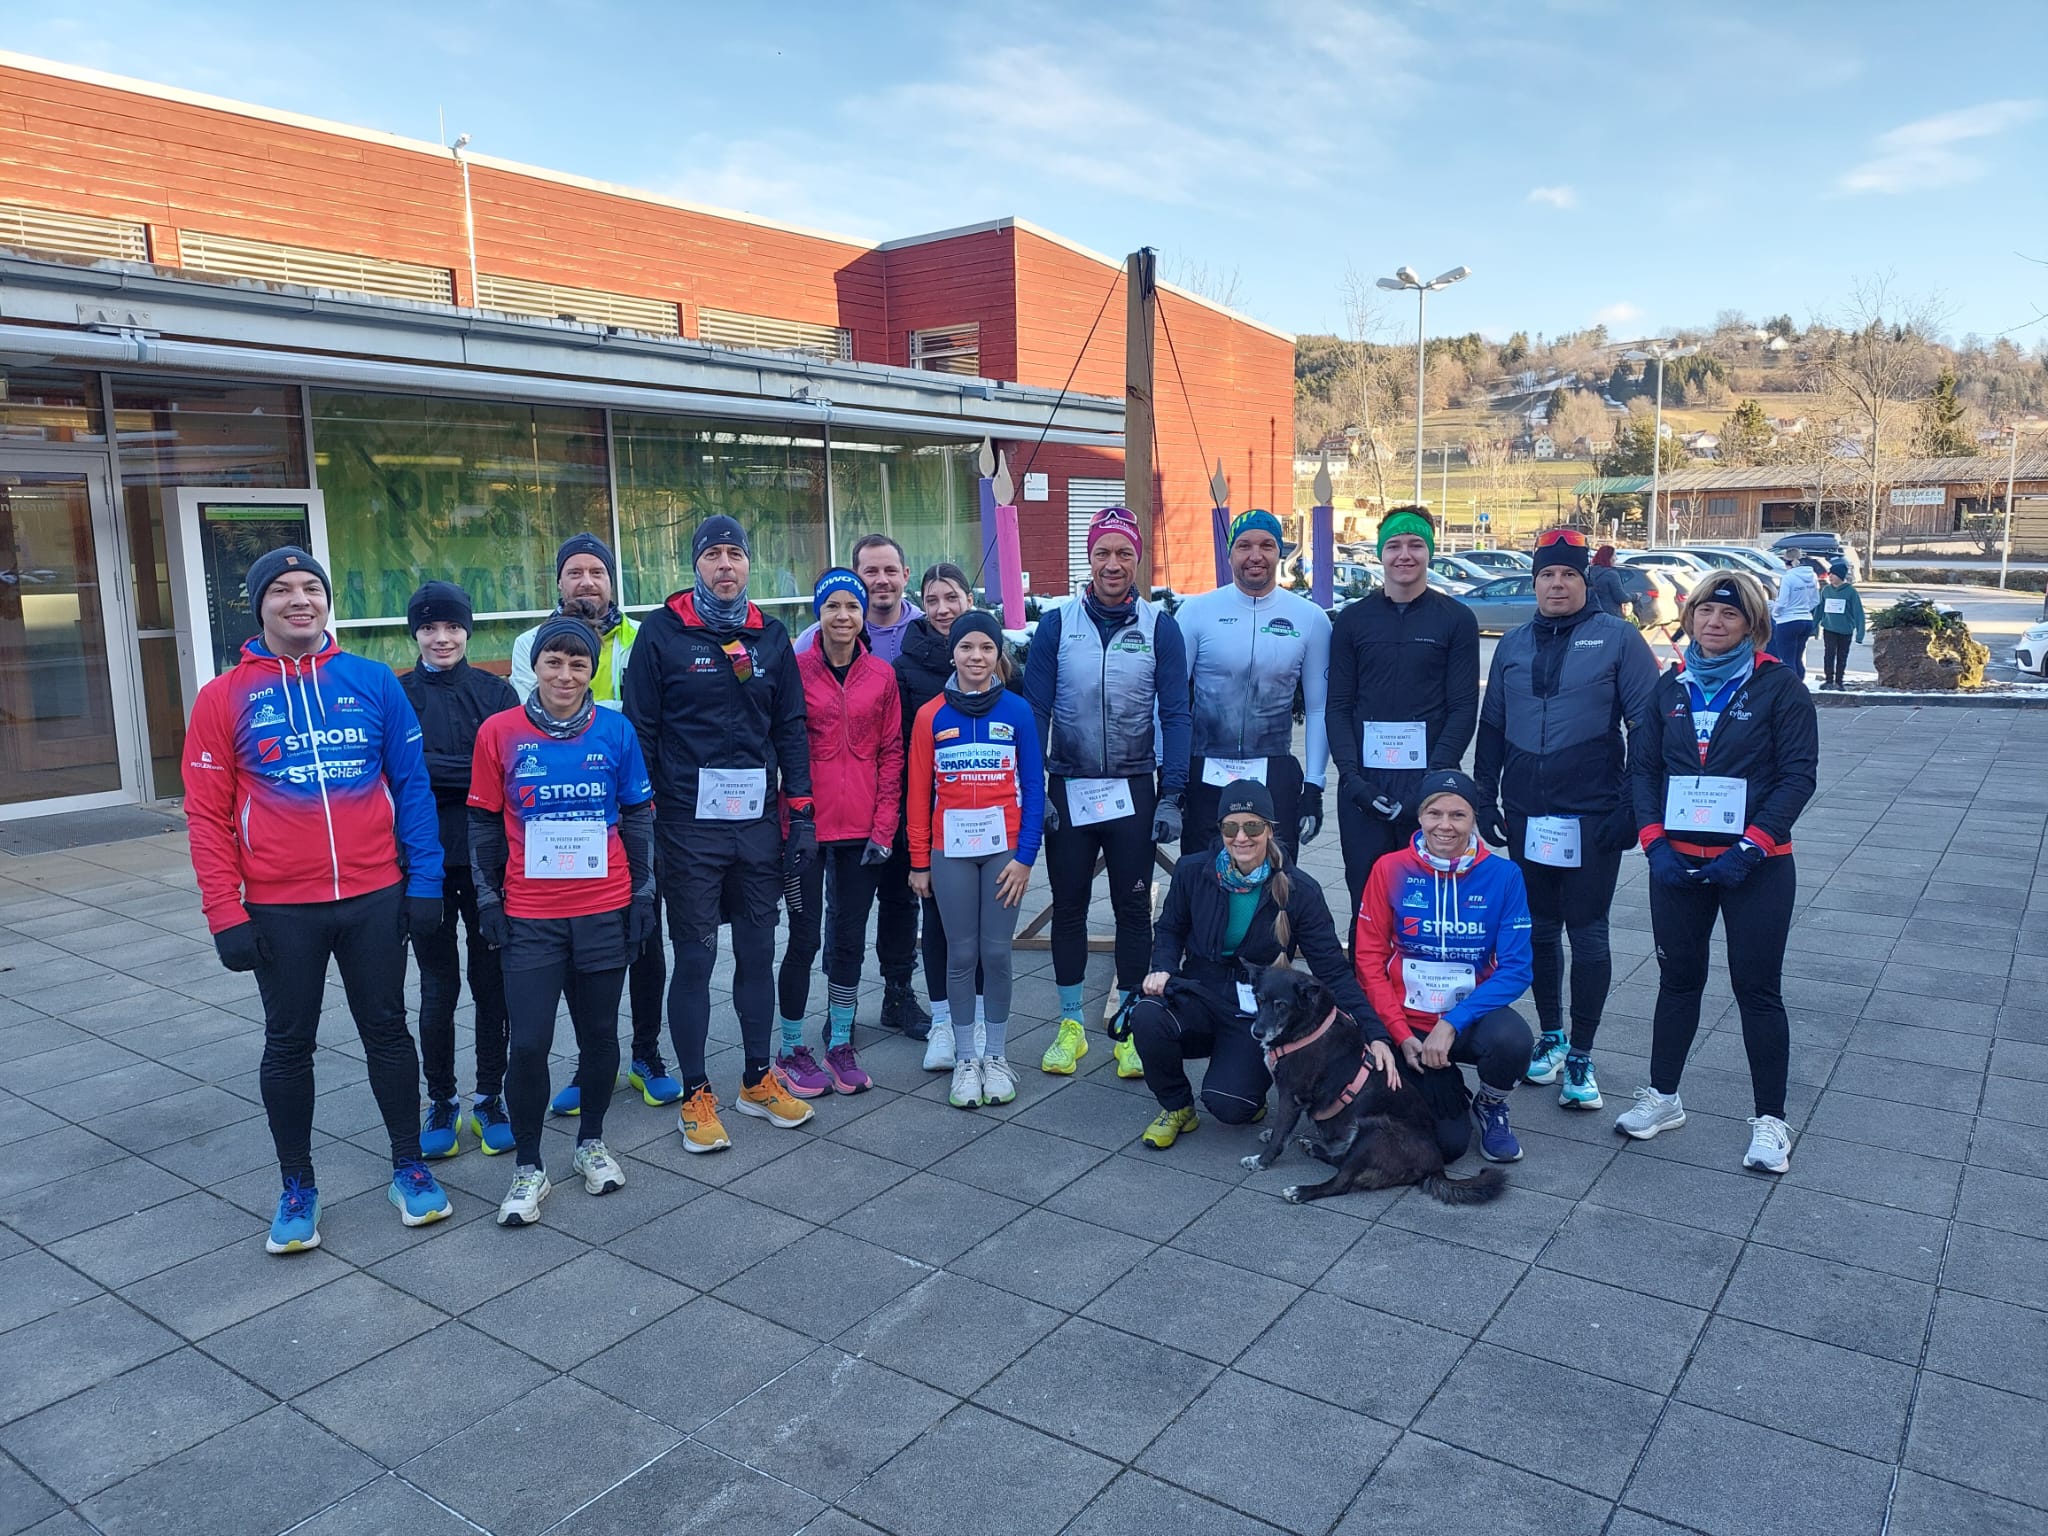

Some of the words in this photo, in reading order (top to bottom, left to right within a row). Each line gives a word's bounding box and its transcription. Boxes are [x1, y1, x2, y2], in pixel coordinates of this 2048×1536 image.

[694, 657, 711, 665] RTR
[285, 728, 368, 751] STROBL
[586, 753, 604, 762] RTR
[938, 748, 1002, 760] Steiermärkische
[940, 759, 1001, 770] SPARKASSE
[539, 782, 607, 800] STROBL
[557, 854, 575, 871] 73
[1422, 919, 1487, 935] STROBL
[1430, 990, 1445, 1008] 44
